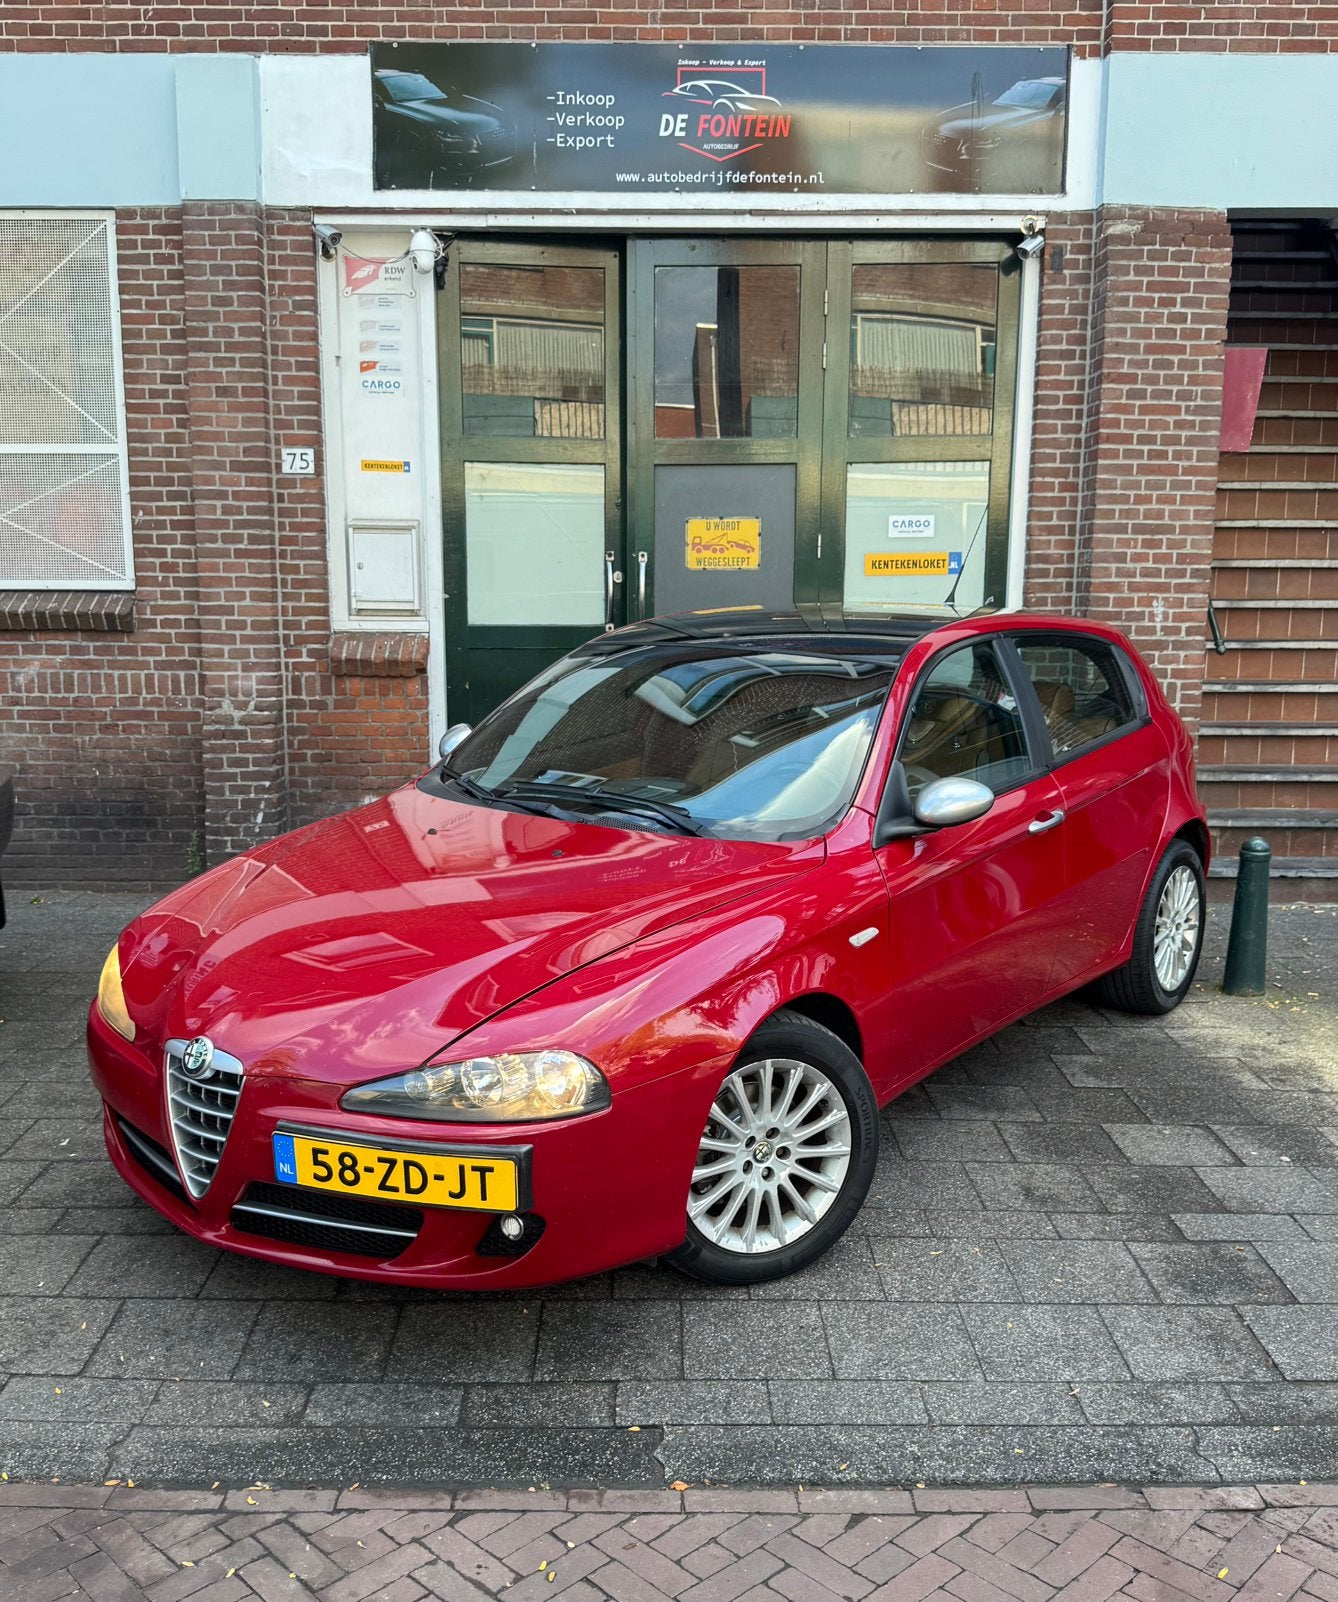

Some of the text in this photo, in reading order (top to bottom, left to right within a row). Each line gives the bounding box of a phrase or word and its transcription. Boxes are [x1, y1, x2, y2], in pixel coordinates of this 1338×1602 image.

[709, 59, 735, 67] Verkoop
[744, 59, 766, 67] Export
[547, 91, 615, 108] -Inkoop
[547, 112, 625, 129] -Verkoop
[659, 113, 791, 138] DE FONTEIN
[547, 133, 615, 150] -Export
[616, 171, 825, 186] www.autobedrijfdefontein.nl
[384, 266, 406, 275] RDW
[362, 380, 400, 389] CARGO
[286, 452, 310, 470] 75
[706, 521, 740, 531] U WORDT
[892, 520, 931, 528] CARGO
[696, 556, 750, 567] WEGGESLEEPT
[871, 558, 947, 570] KENTEKENLOKET
[279, 1161, 294, 1175] NL
[311, 1147, 495, 1202] 58-ZD-JT
